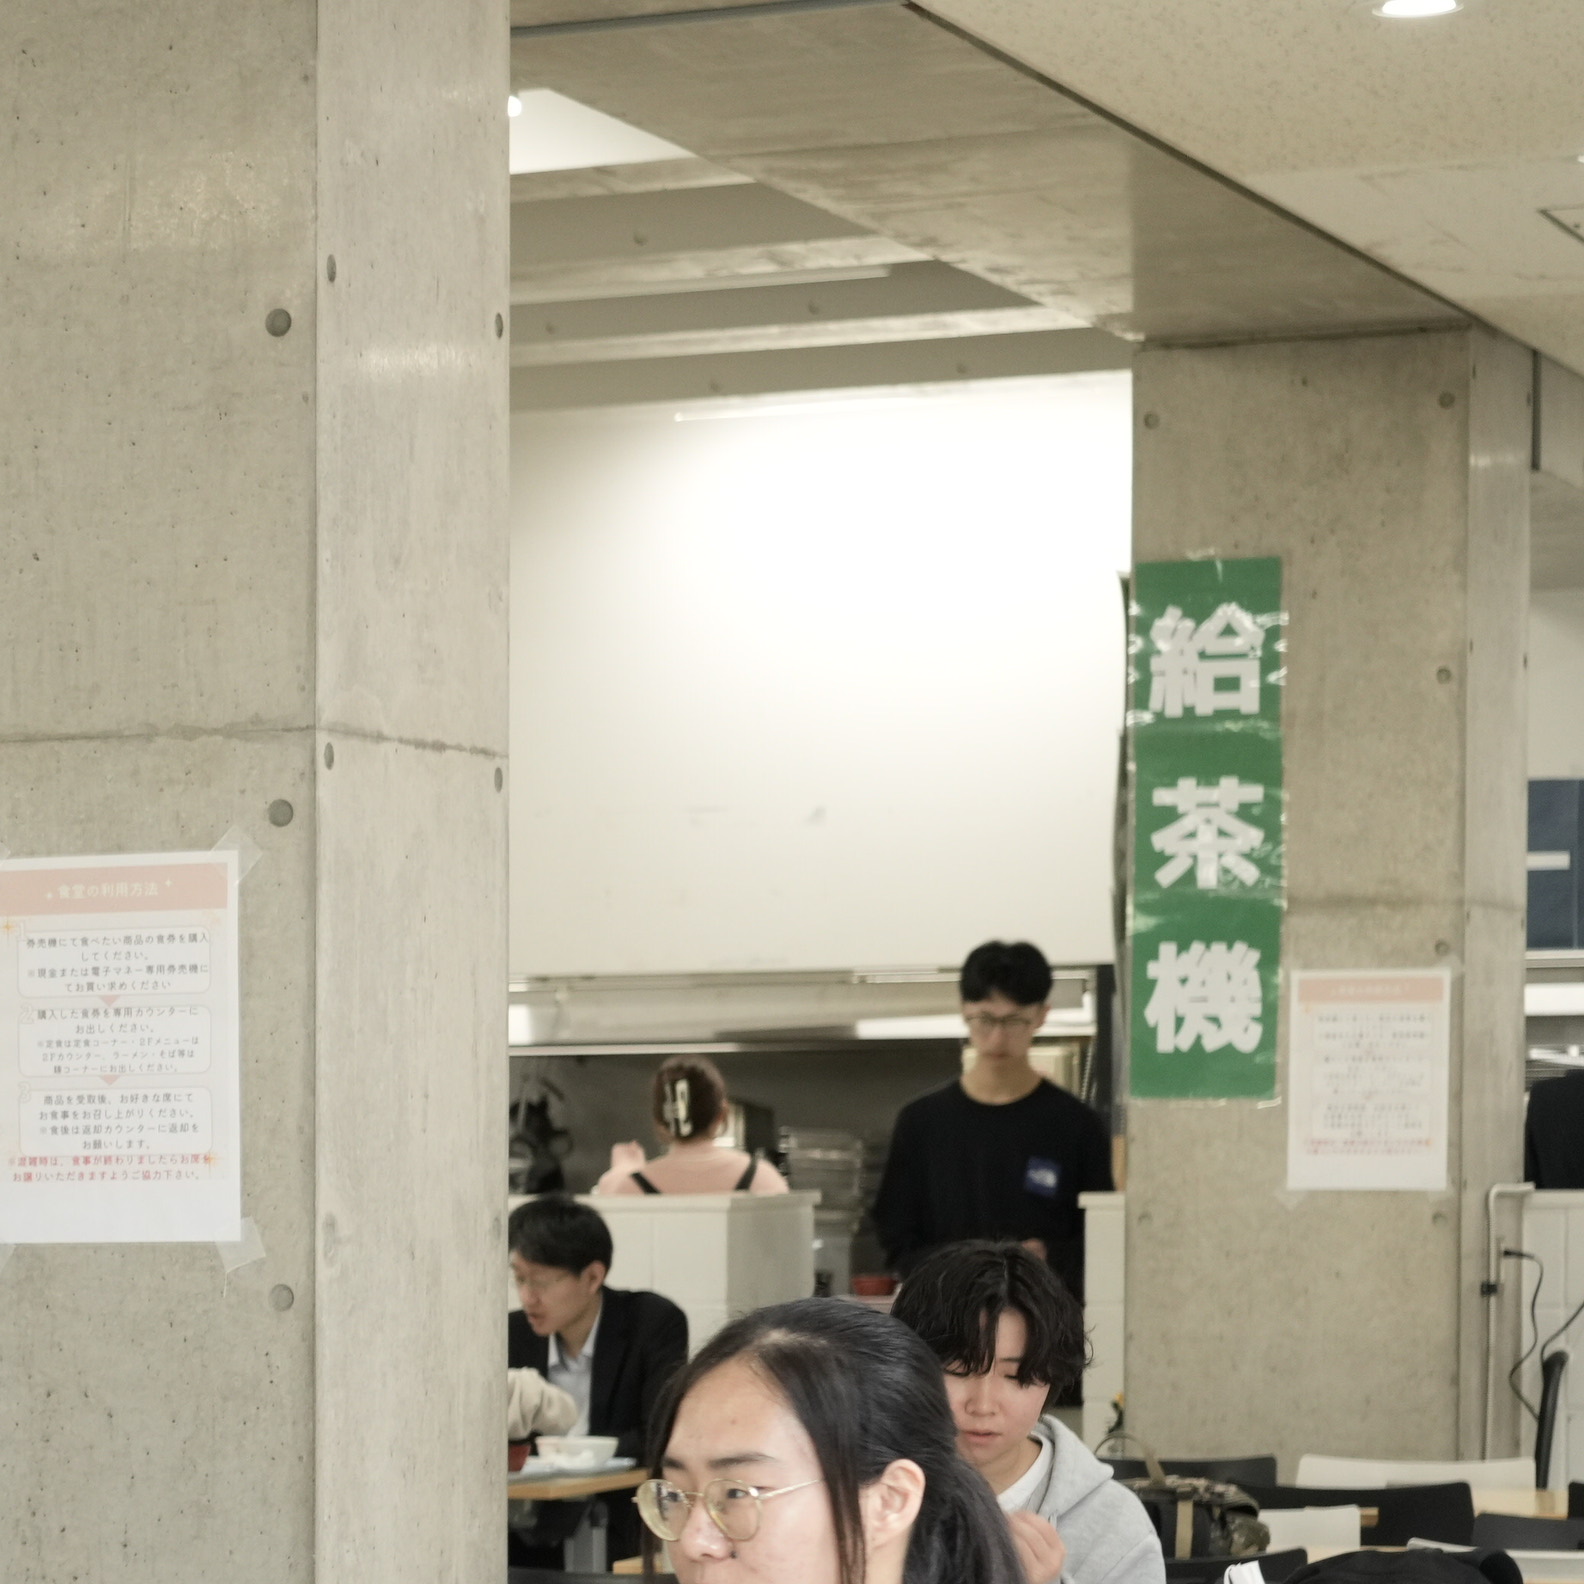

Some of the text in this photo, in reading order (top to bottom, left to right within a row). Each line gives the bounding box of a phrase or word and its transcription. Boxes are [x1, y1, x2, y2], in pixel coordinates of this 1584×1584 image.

[57, 882, 159, 899] 食堂の利用方法
[1144, 602, 1265, 1053] 給茶機
